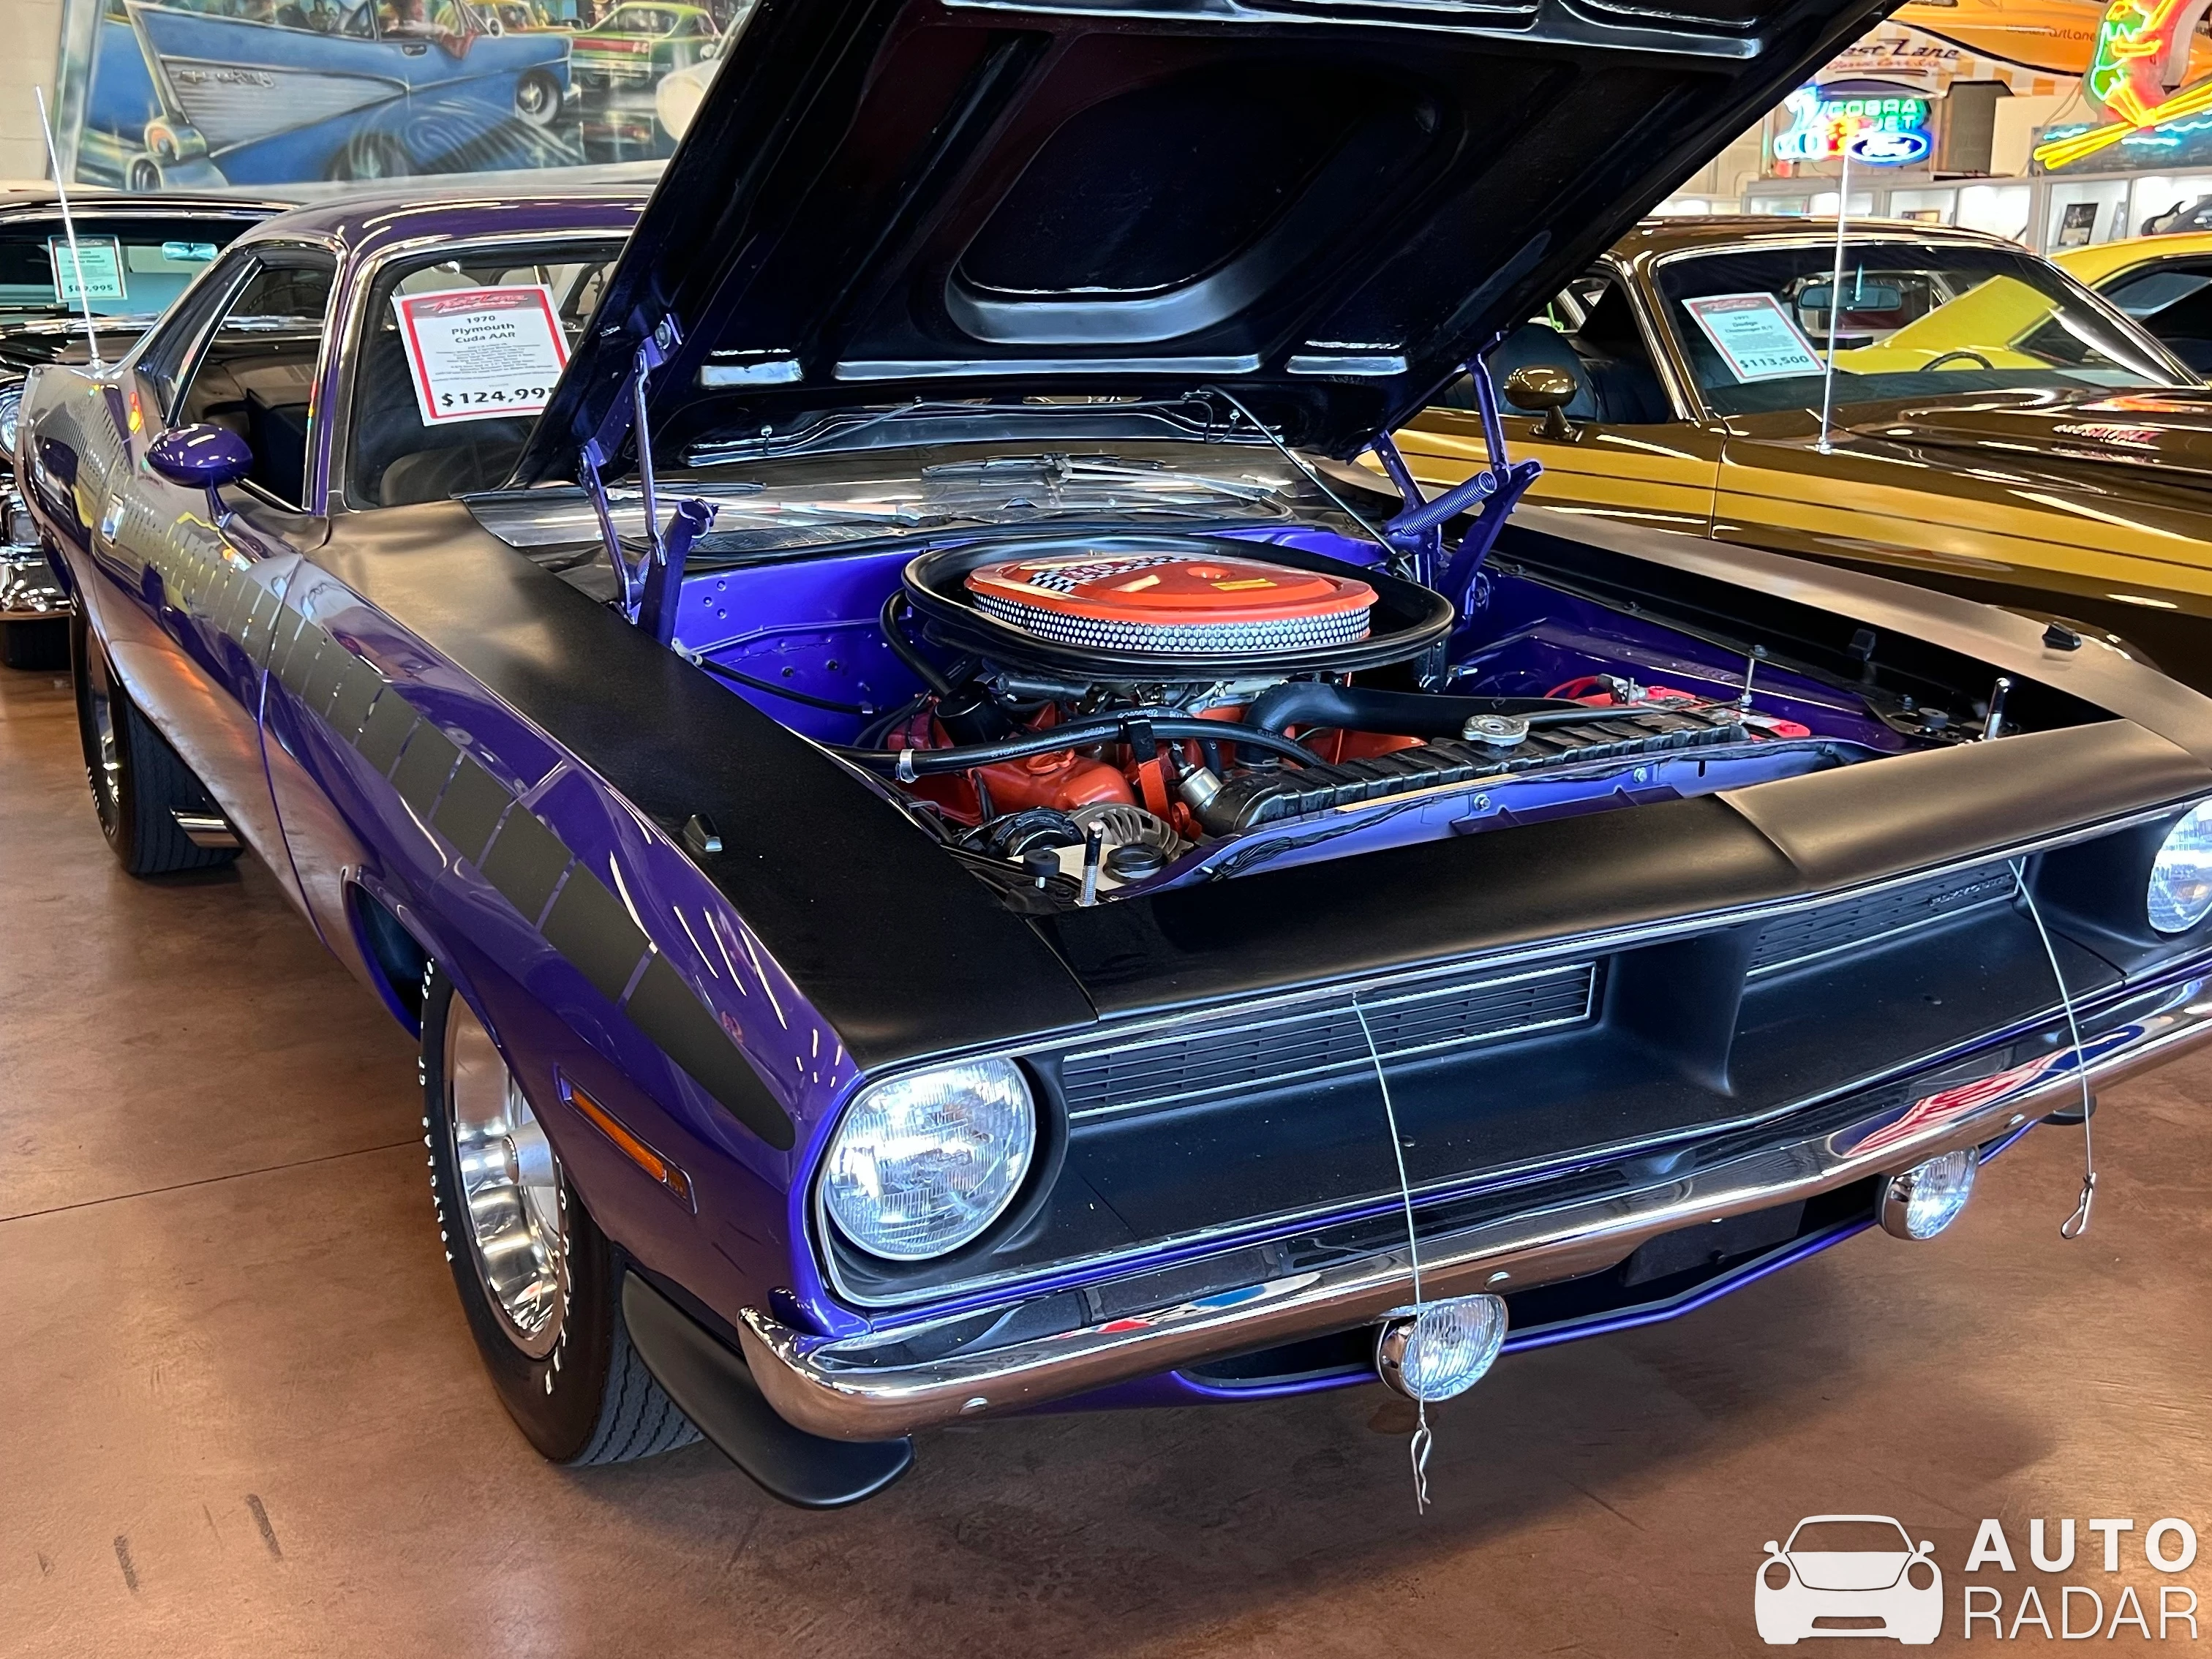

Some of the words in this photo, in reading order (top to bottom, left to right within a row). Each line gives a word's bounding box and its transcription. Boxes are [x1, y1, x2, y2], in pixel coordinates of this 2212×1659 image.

[1839, 40, 1885, 56] ast
[1828, 99, 1918, 118] COBRA
[1873, 115, 1917, 132] JET
[467, 315, 496, 324] 1970
[451, 323, 515, 336] Plymouth
[455, 335, 486, 344] Cuda
[489, 331, 516, 340] AAR
[1739, 356, 1810, 369] $113,500
[441, 386, 554, 407] $124,99
